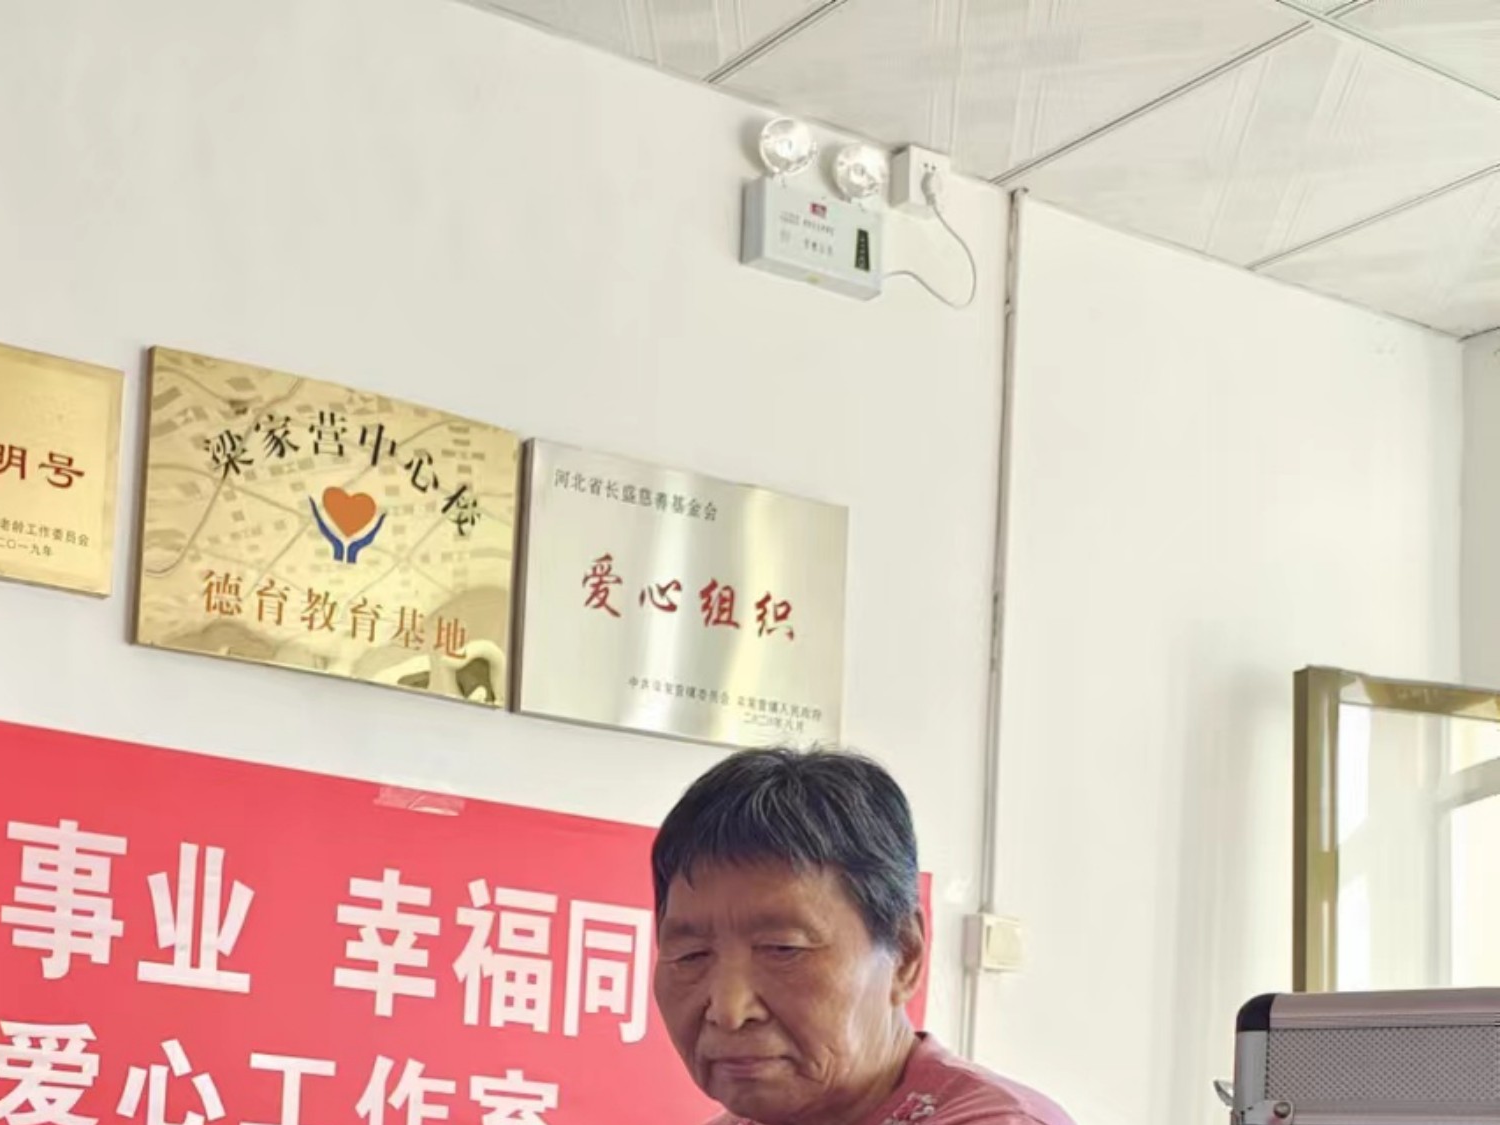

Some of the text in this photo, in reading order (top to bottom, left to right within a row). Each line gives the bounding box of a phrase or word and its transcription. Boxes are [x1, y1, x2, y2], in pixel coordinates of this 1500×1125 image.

[201, 569, 468, 660] 德育教育基地
[582, 553, 795, 640] 爱心组织
[332, 868, 657, 1044] 幸福同
